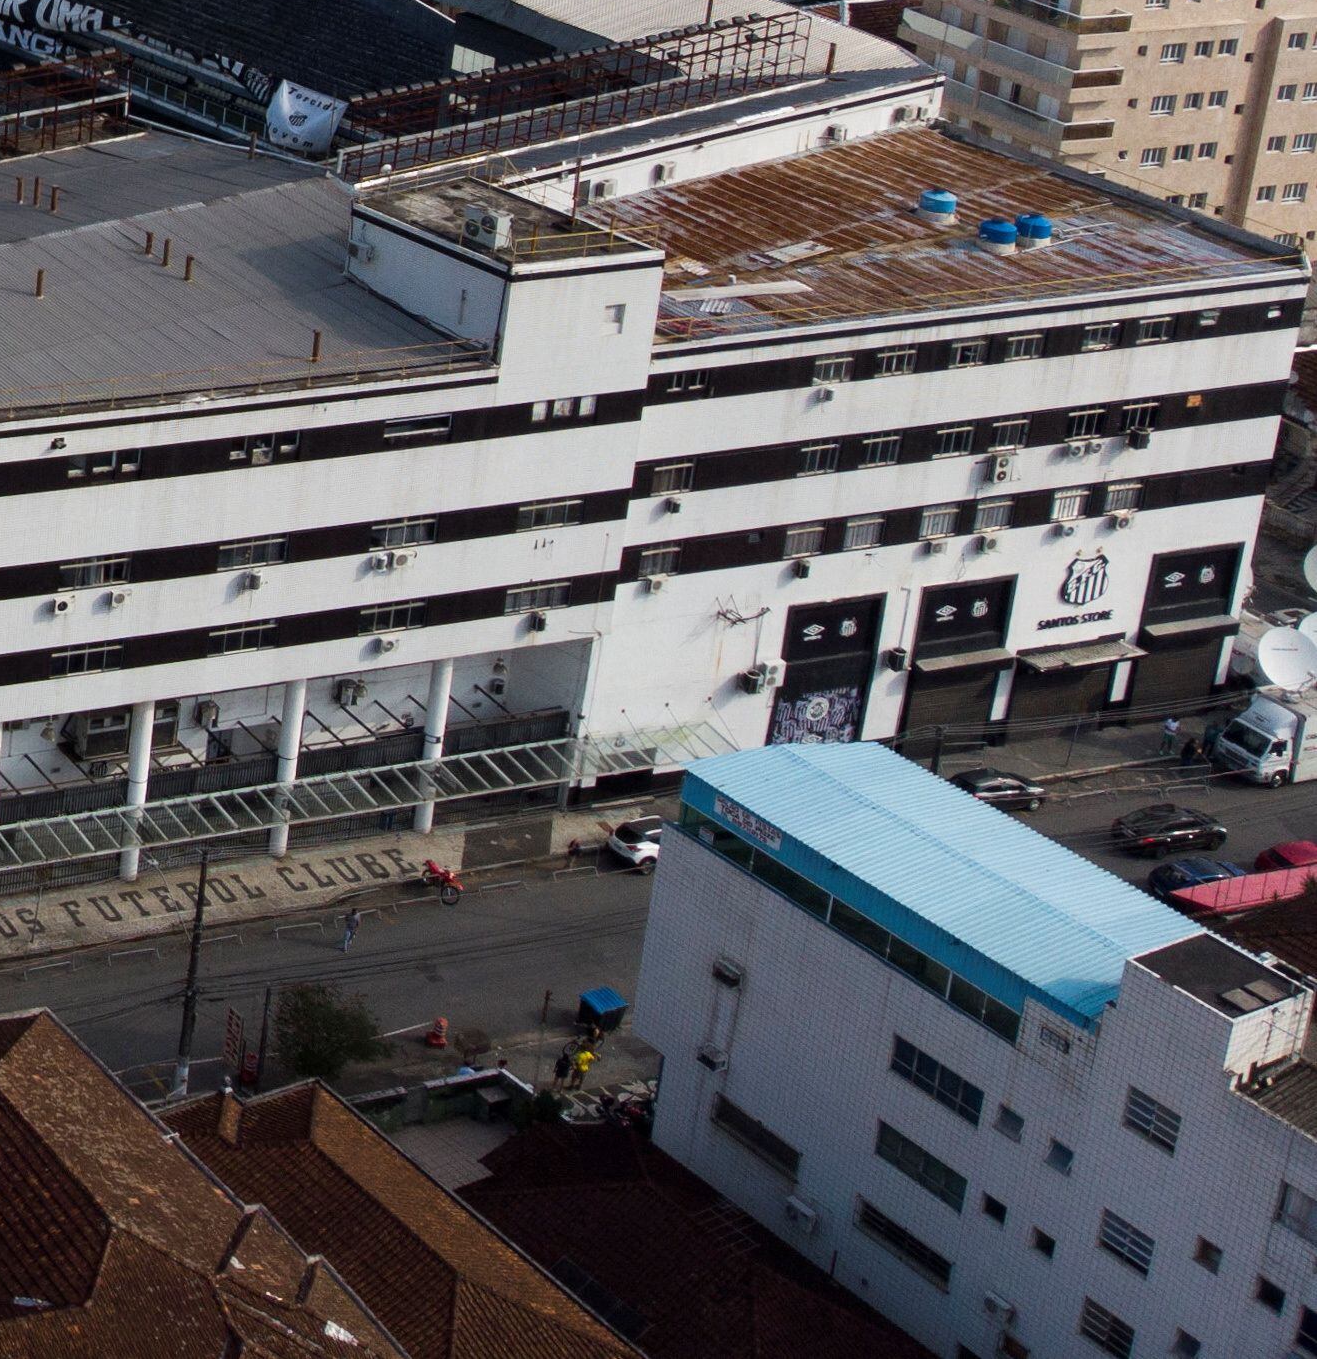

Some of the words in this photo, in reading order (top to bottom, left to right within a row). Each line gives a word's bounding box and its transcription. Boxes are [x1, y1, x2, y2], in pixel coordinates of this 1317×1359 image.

[1036, 615, 1079, 631] SANTOS
[1080, 609, 1114, 624] STORE
[59, 870, 267, 929] FUTEBOL
[275, 848, 423, 892] CLUBE
